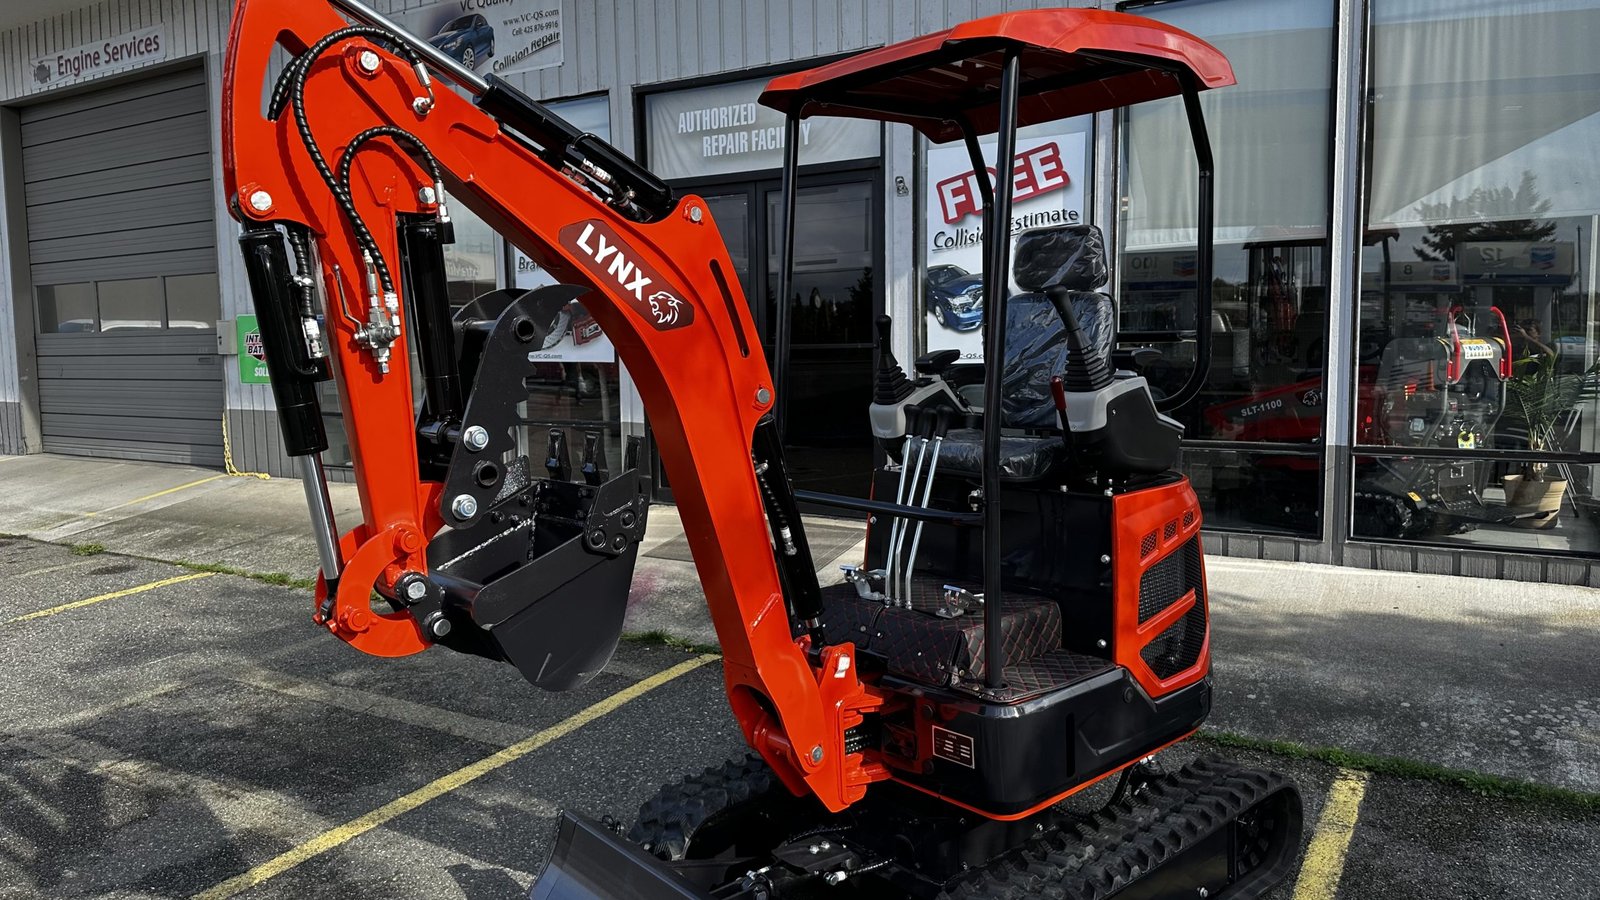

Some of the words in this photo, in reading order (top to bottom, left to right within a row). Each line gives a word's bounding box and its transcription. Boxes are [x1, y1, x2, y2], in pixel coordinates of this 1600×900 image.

[460, 0, 475, 12] VC
[503, 9, 560, 26] www.VC-QS.com
[523, 25, 534, 34] 425
[534, 20, 559, 32] 876-9916
[57, 50, 101, 77] Engine
[103, 35, 160, 64] Services
[493, 46, 529, 73] Collision
[530, 31, 560, 51] Repair
[678, 102, 757, 134] AUTHORIZED
[703, 131, 749, 157] REPAIR
[752, 122, 811, 152] FACILY
[518, 256, 541, 271] Bra
[576, 223, 653, 301] LYNX
[1241, 399, 1282, 417] SLT-1100
